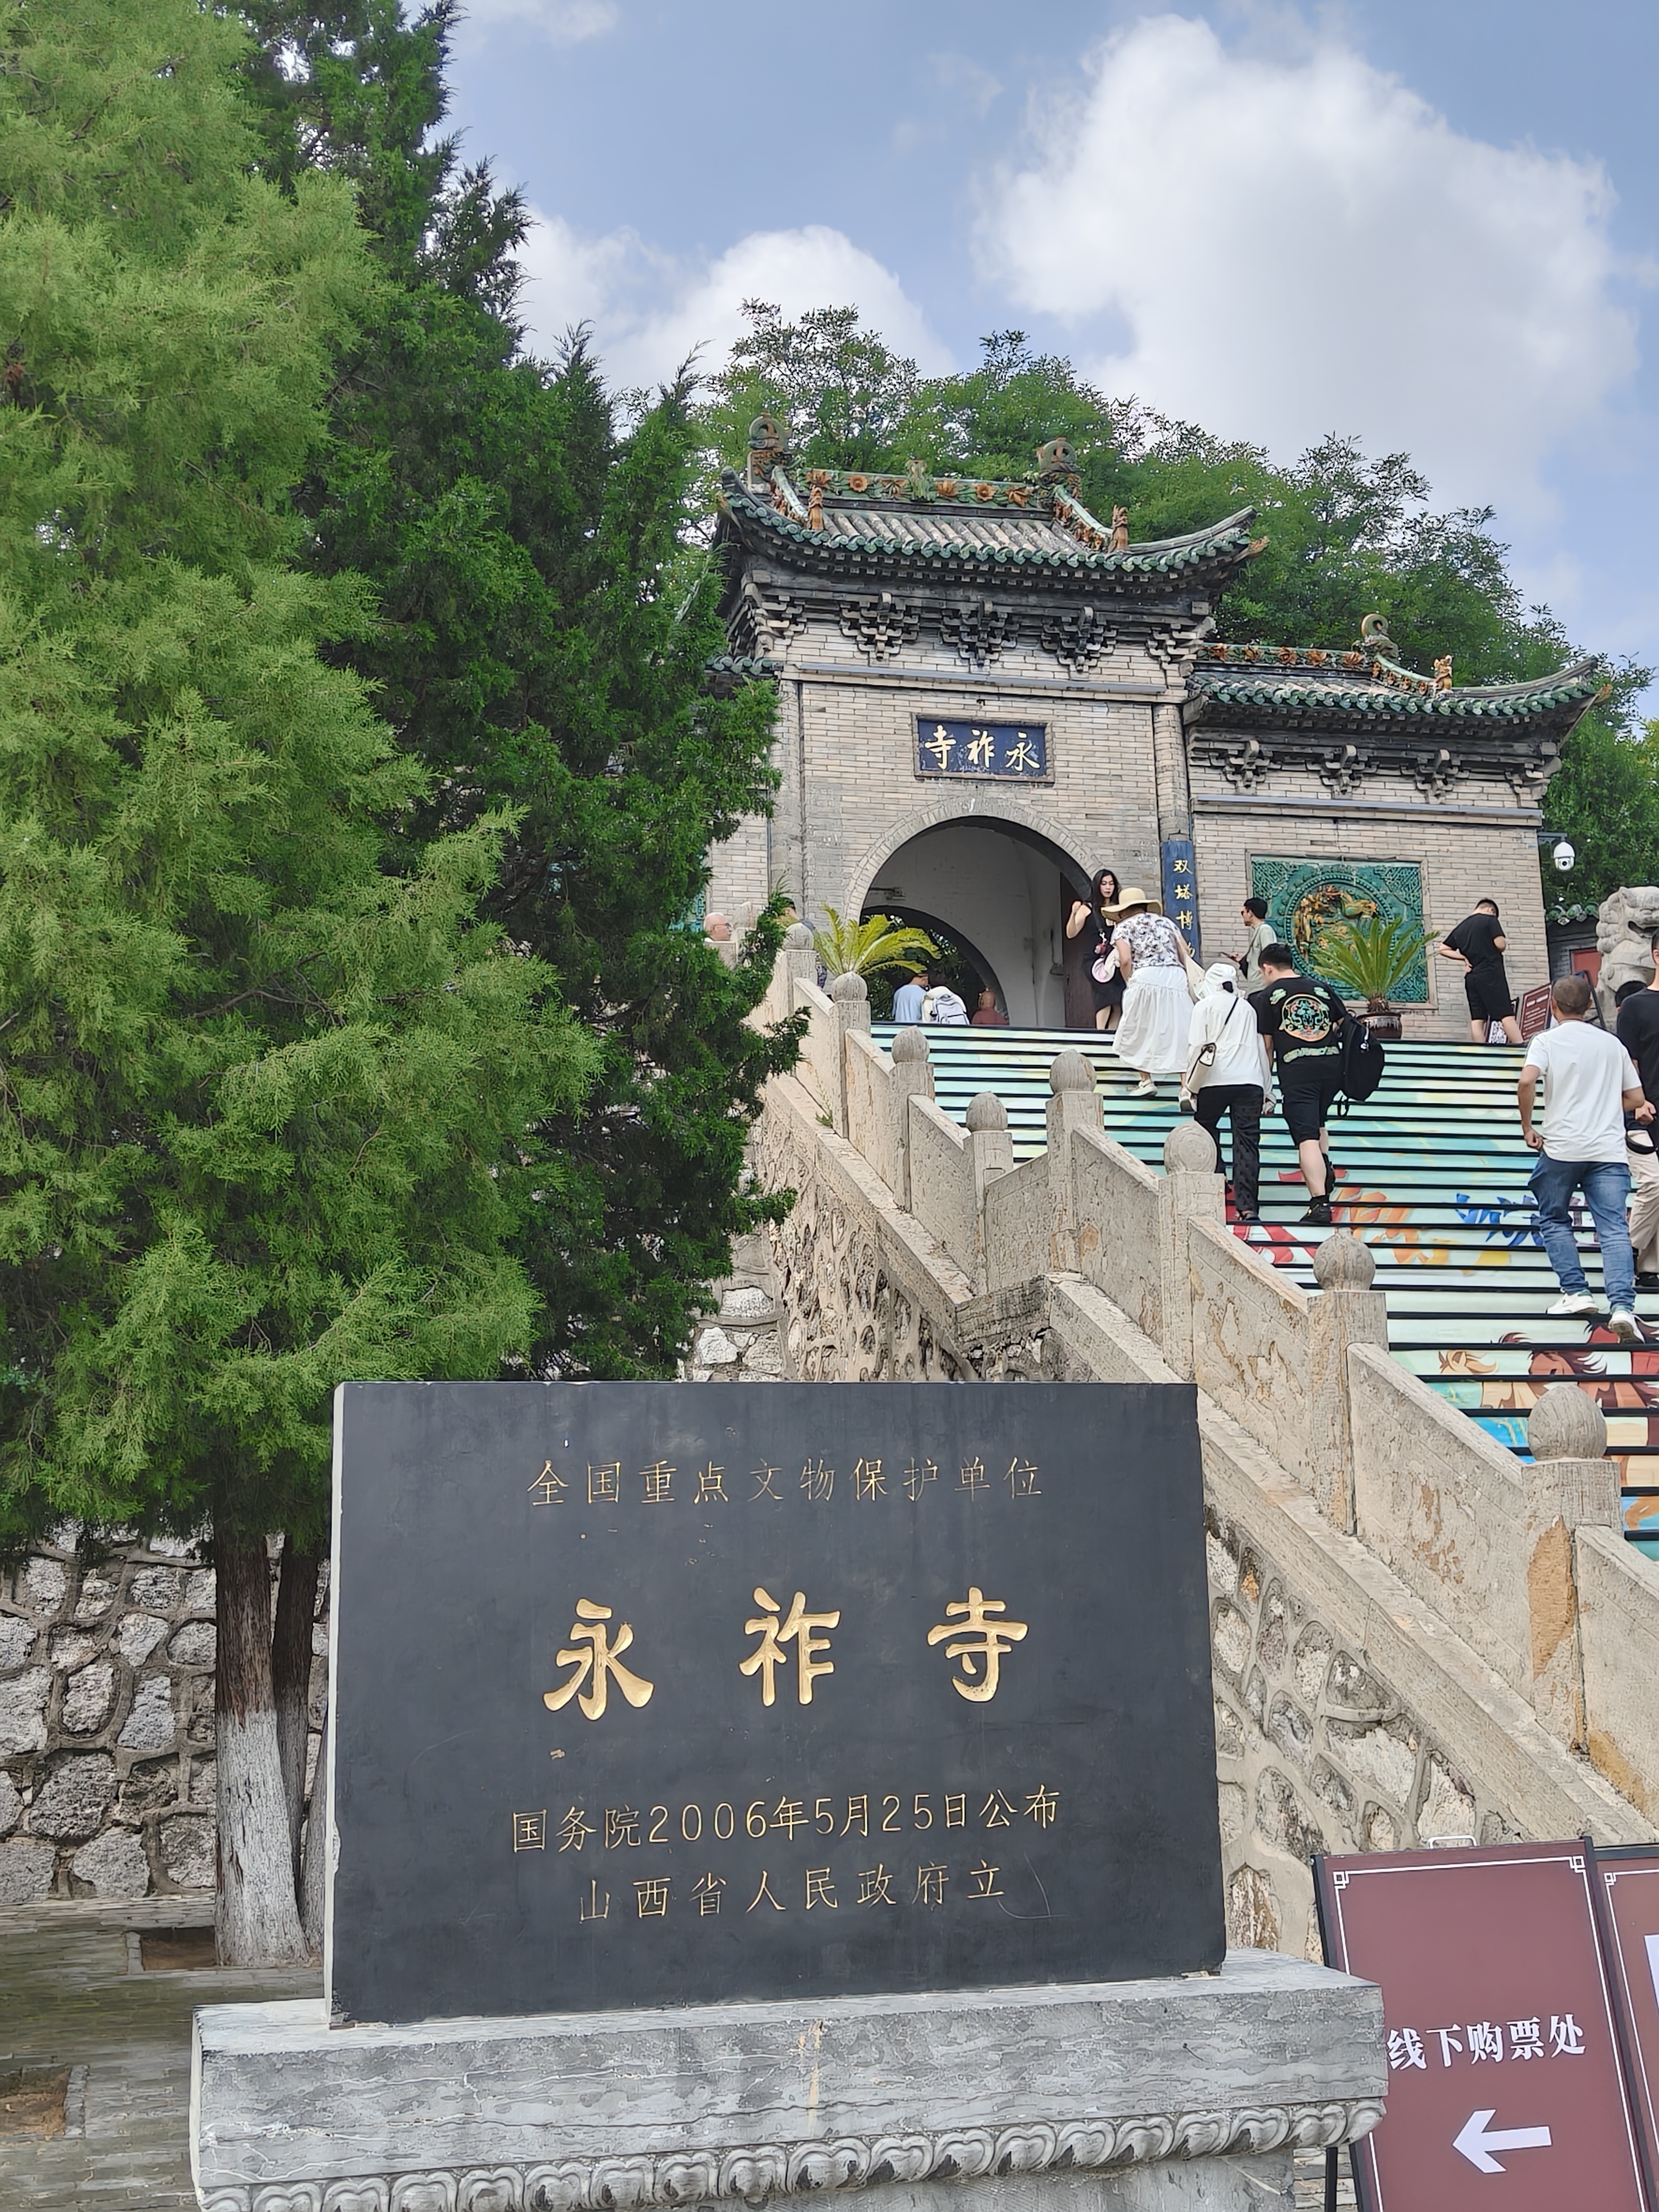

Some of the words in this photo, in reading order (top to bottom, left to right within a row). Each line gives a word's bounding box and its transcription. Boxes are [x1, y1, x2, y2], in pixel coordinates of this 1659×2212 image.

[924, 724, 1041, 772] 永祚寺
[526, 1456, 1043, 1507] 全国重点文物保护单位
[542, 1586, 1029, 1721] 永祚寺
[511, 1783, 1061, 1853] 国务院2006年5月25日公布
[579, 1858, 1004, 1924] 山西省人民政府立
[1386, 2013, 1586, 2071] 线下购票处
